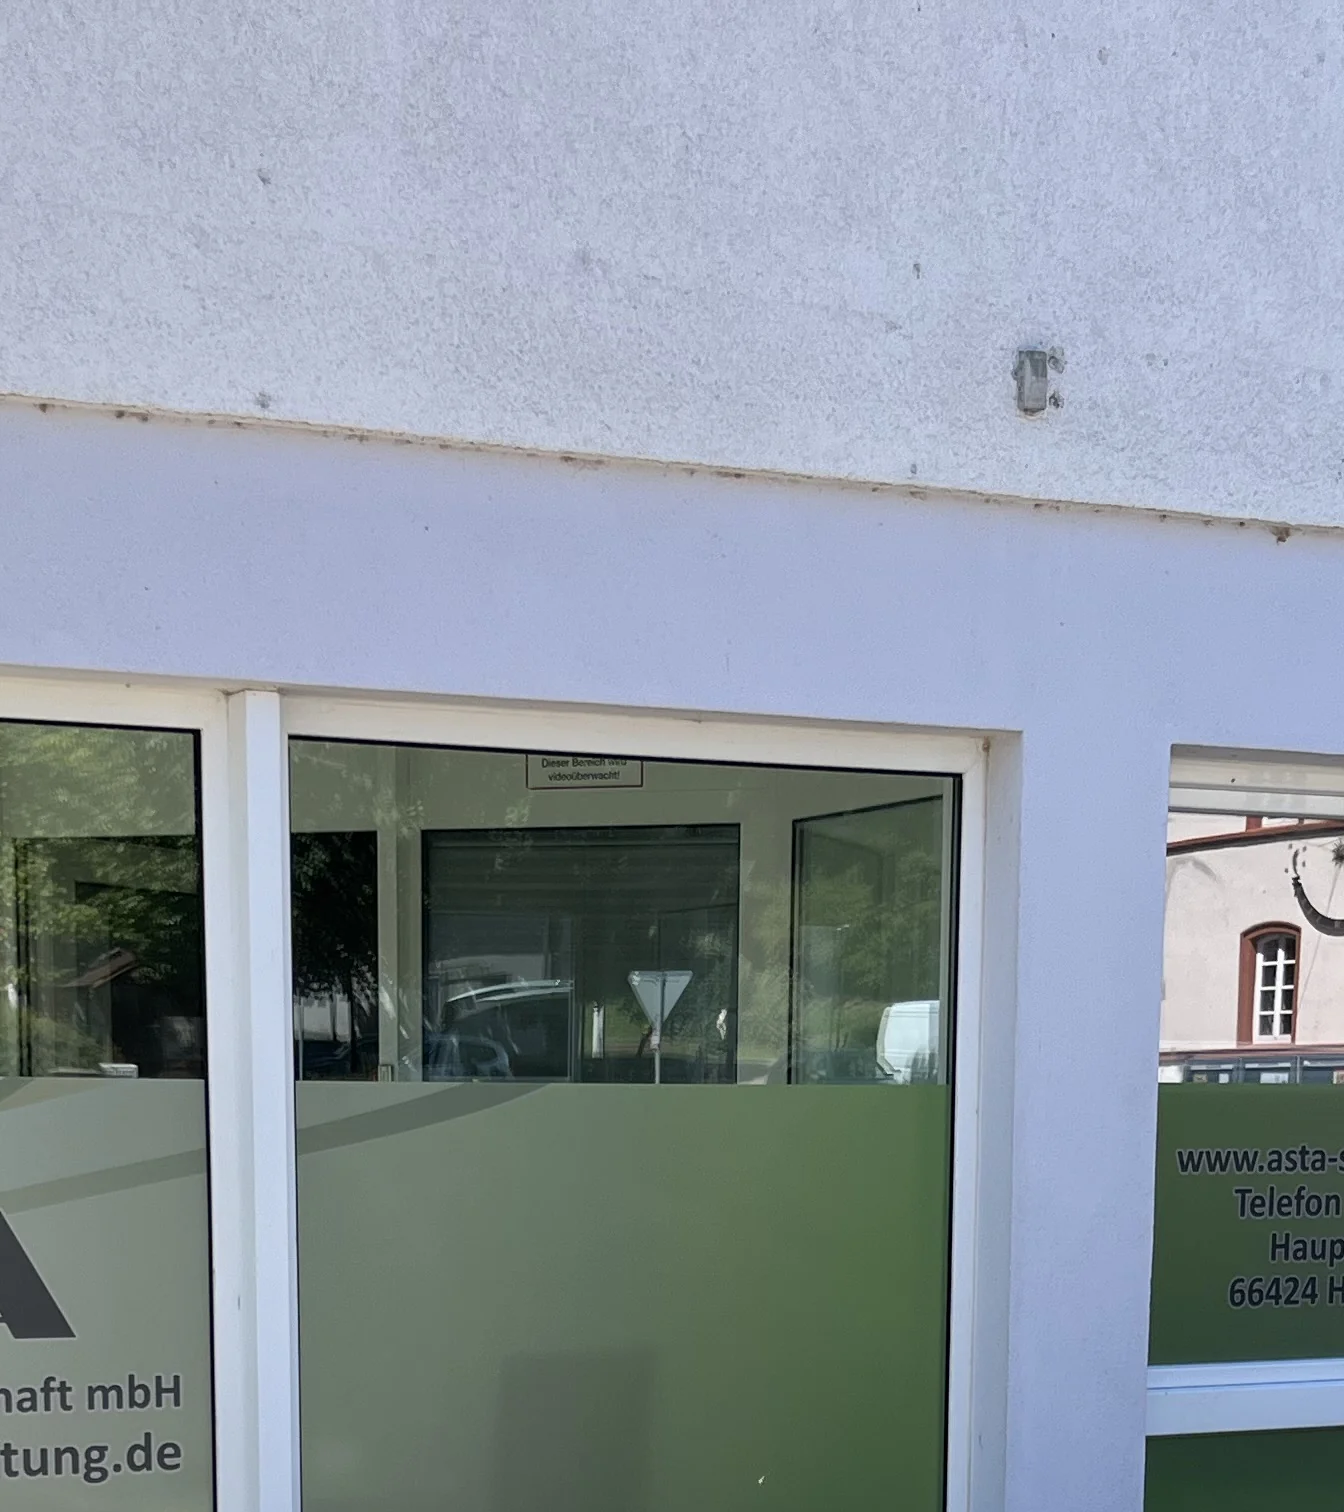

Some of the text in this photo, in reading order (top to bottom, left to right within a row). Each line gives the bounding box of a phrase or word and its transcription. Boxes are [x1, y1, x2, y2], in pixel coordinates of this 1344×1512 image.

[541, 758, 569, 768] Dieser
[571, 757, 606, 768] Bereich
[548, 771, 620, 782] videoüberwacht!
[1234, 1187, 1341, 1218] Telefon
[1229, 1276, 1319, 1307] 66424
[86, 1374, 182, 1412] mbH
